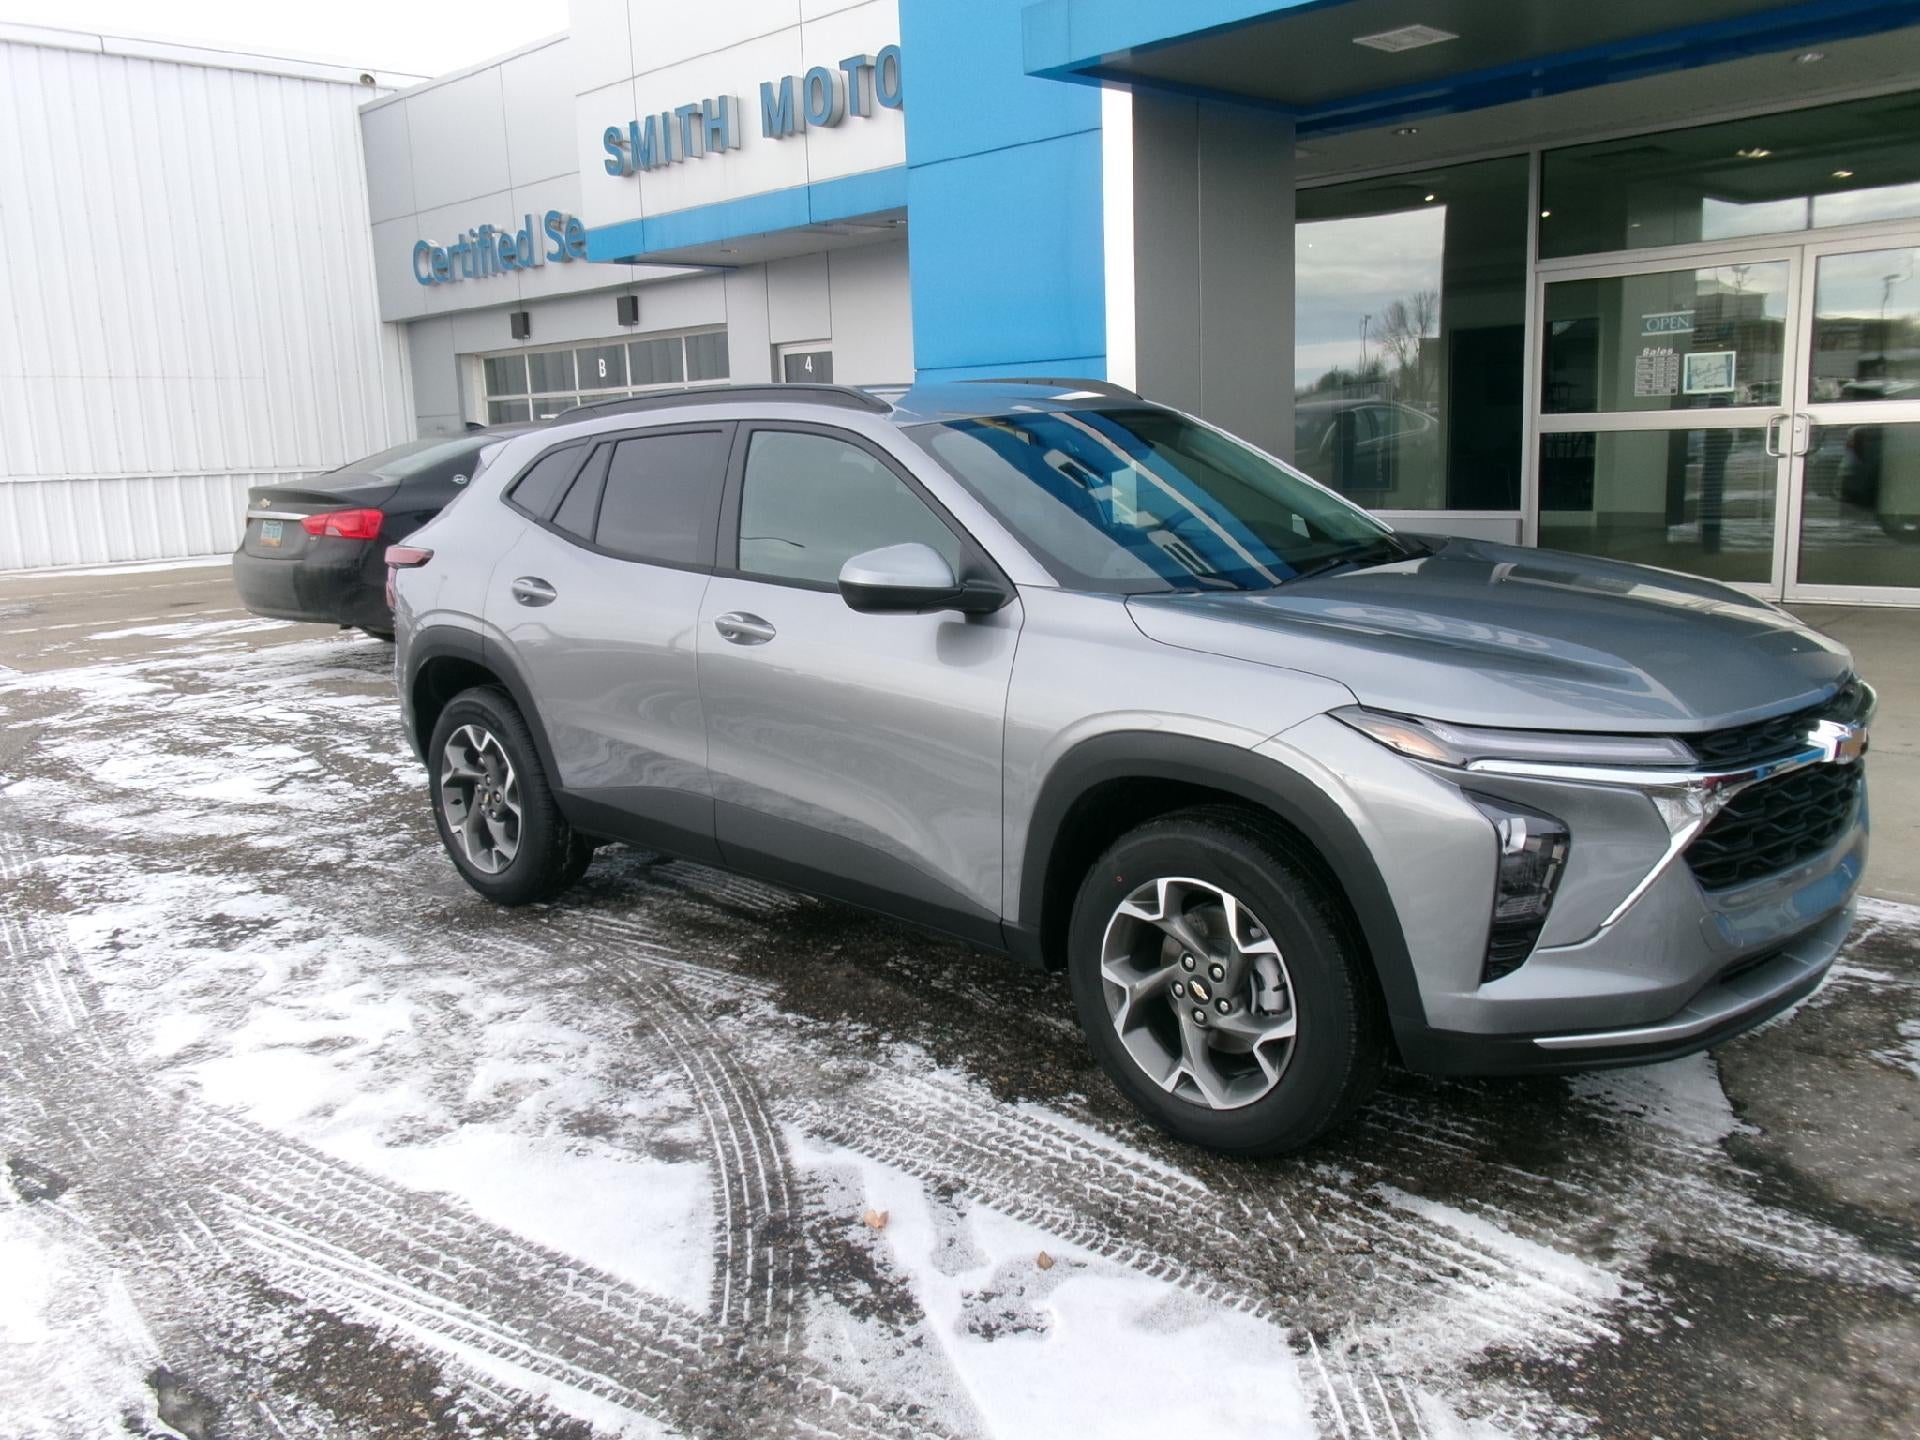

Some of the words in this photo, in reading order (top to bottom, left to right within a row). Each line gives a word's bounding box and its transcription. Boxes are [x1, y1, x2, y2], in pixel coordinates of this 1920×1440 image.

[603, 94, 738, 177] SMITH
[413, 213, 541, 286] Certified
[1646, 315, 1690, 332] OPEN
[598, 358, 607, 379] B
[803, 355, 813, 374] 4
